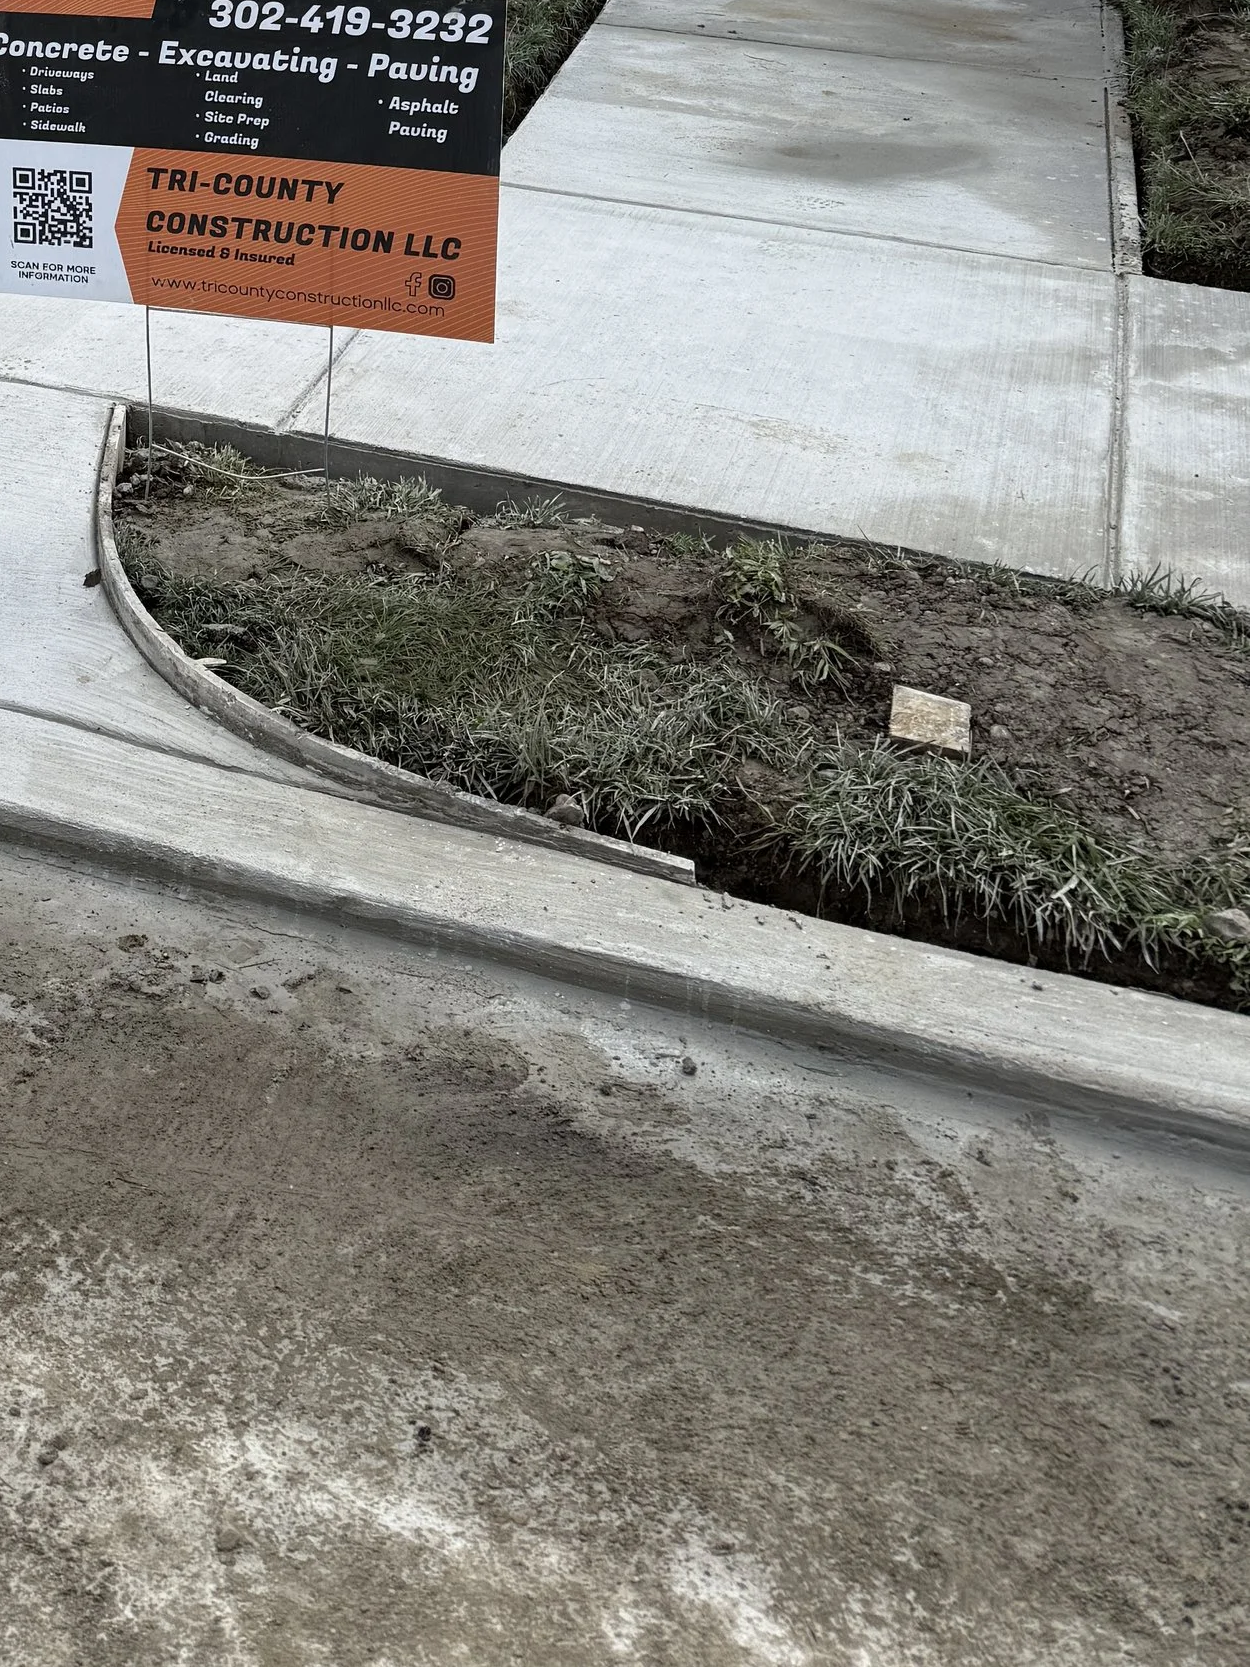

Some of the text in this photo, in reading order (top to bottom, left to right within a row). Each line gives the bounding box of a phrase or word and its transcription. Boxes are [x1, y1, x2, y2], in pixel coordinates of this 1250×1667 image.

[30, 66, 95, 81] Driveways
[158, 40, 339, 83] Excavating
[367, 52, 479, 94] Paving
[204, 69, 239, 84] Land
[30, 84, 63, 96] Slabs
[204, 90, 263, 108] Clearing
[30, 102, 70, 114] Patios
[388, 96, 460, 116] Asphalt
[30, 119, 86, 133] Sidewalk
[204, 110, 270, 130] Site Prep
[204, 131, 260, 150] Grading
[388, 121, 448, 144] Paving
[146, 167, 345, 205] TRI-COUNTY
[146, 210, 463, 261] CONSTRUCTION LLC
[147, 240, 216, 259] Licensed
[234, 248, 296, 266] Insured
[10, 260, 96, 275] SCAN FOR MORE
[18, 271, 89, 284] INFORMATION
[151, 275, 445, 317] www.tricountyconstructionllc.com
